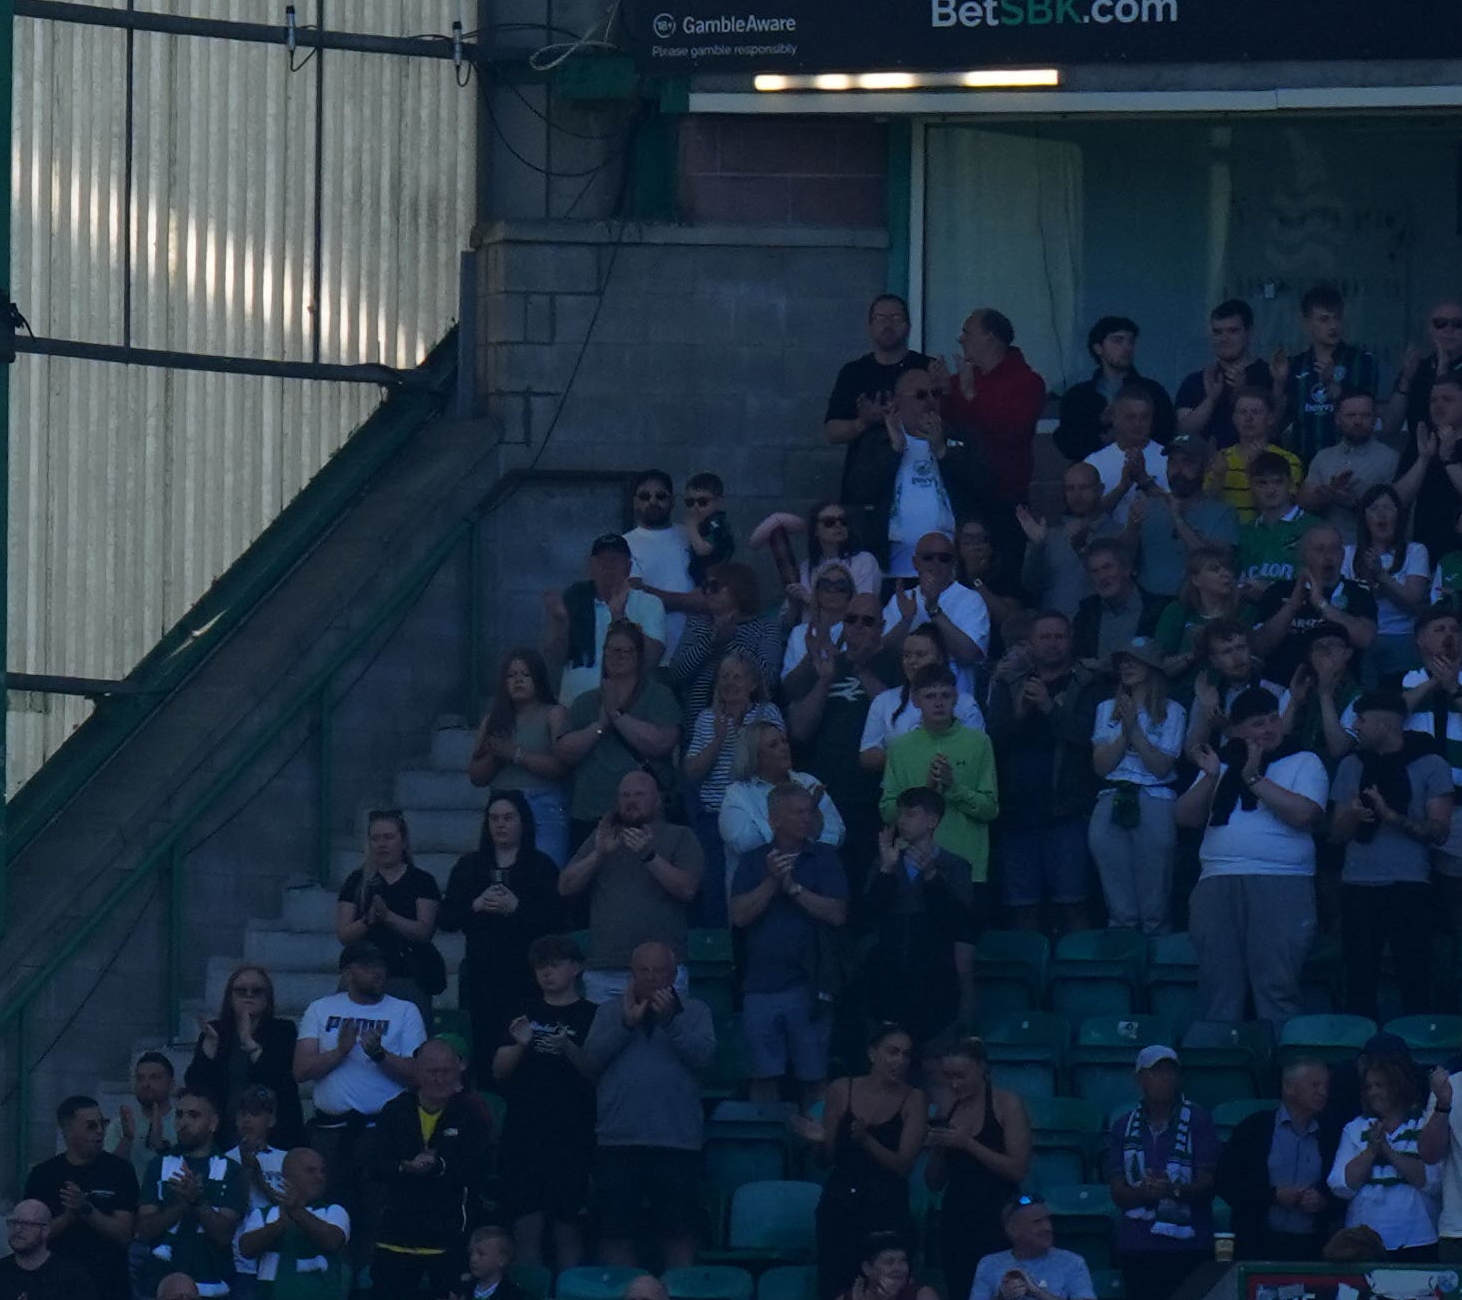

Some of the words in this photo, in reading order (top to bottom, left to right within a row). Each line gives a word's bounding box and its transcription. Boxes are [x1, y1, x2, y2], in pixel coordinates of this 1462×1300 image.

[682, 14, 797, 35] GambleAware
[690, 43, 733, 58] gamble
[734, 42, 799, 57] responsibly
